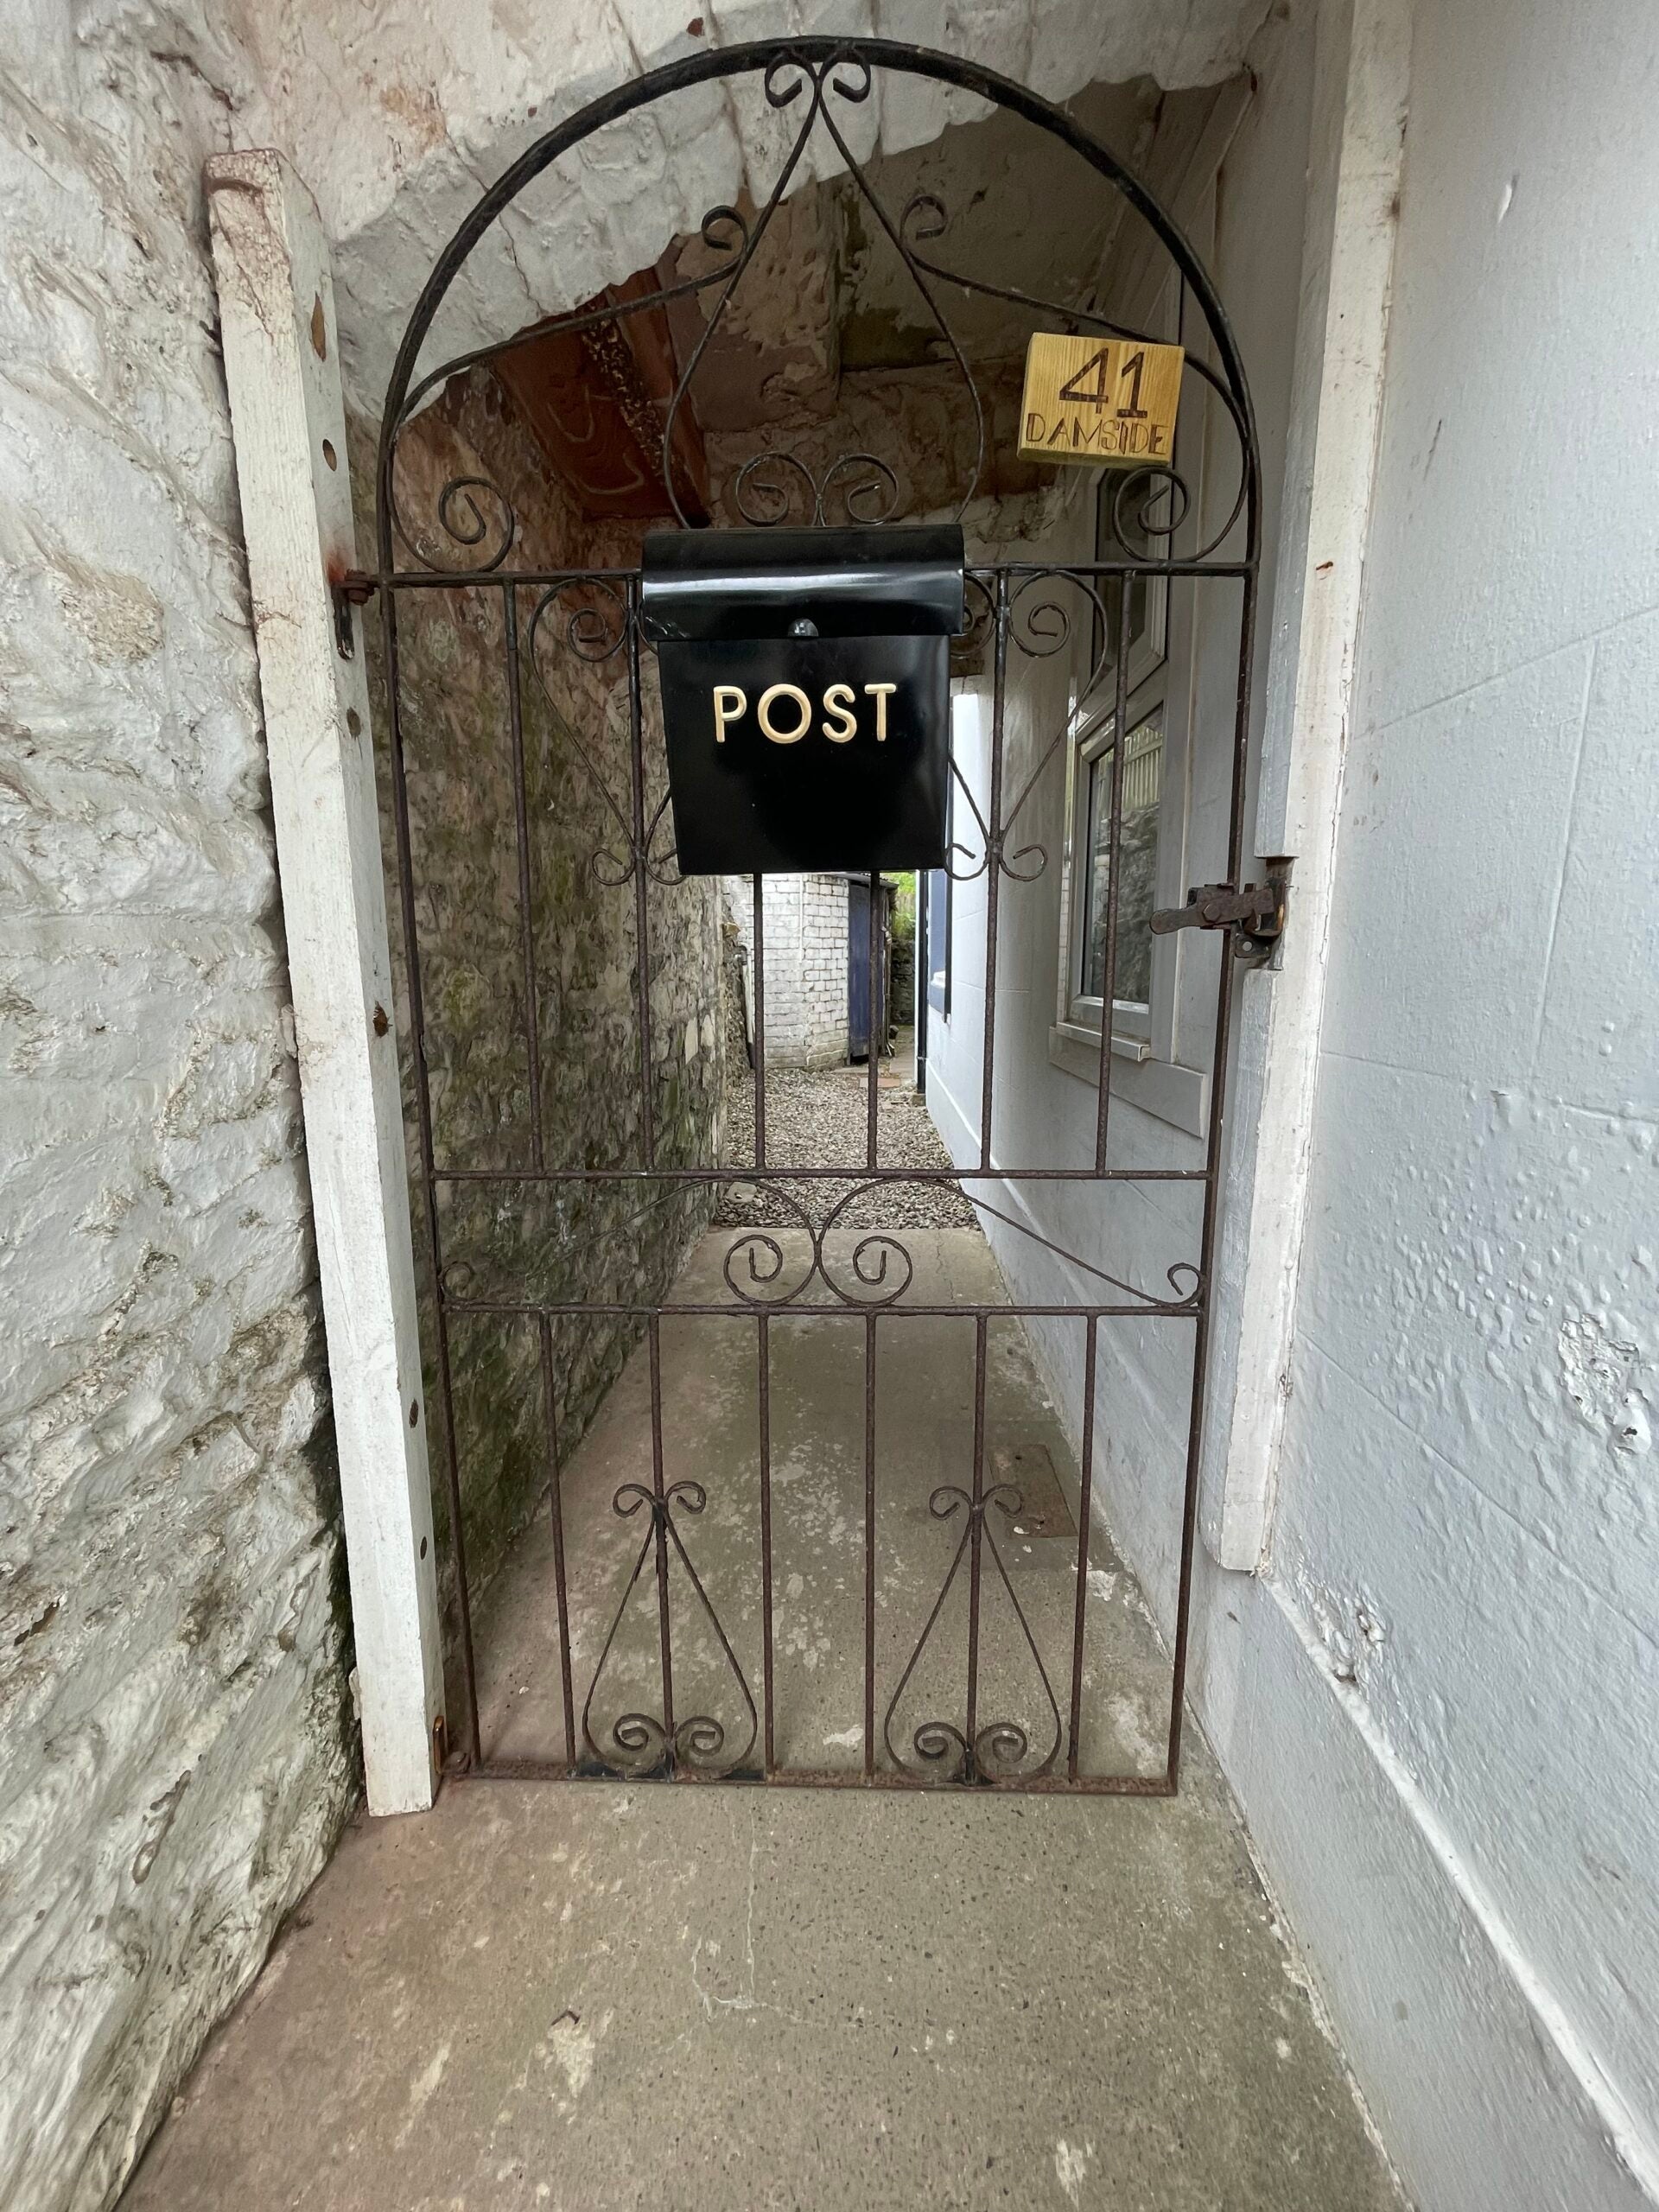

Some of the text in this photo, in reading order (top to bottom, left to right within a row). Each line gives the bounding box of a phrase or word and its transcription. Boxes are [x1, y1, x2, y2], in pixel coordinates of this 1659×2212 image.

[1059, 347, 1147, 418] 41
[1026, 413, 1169, 454] DAMSIDE
[714, 683, 896, 744] POST
